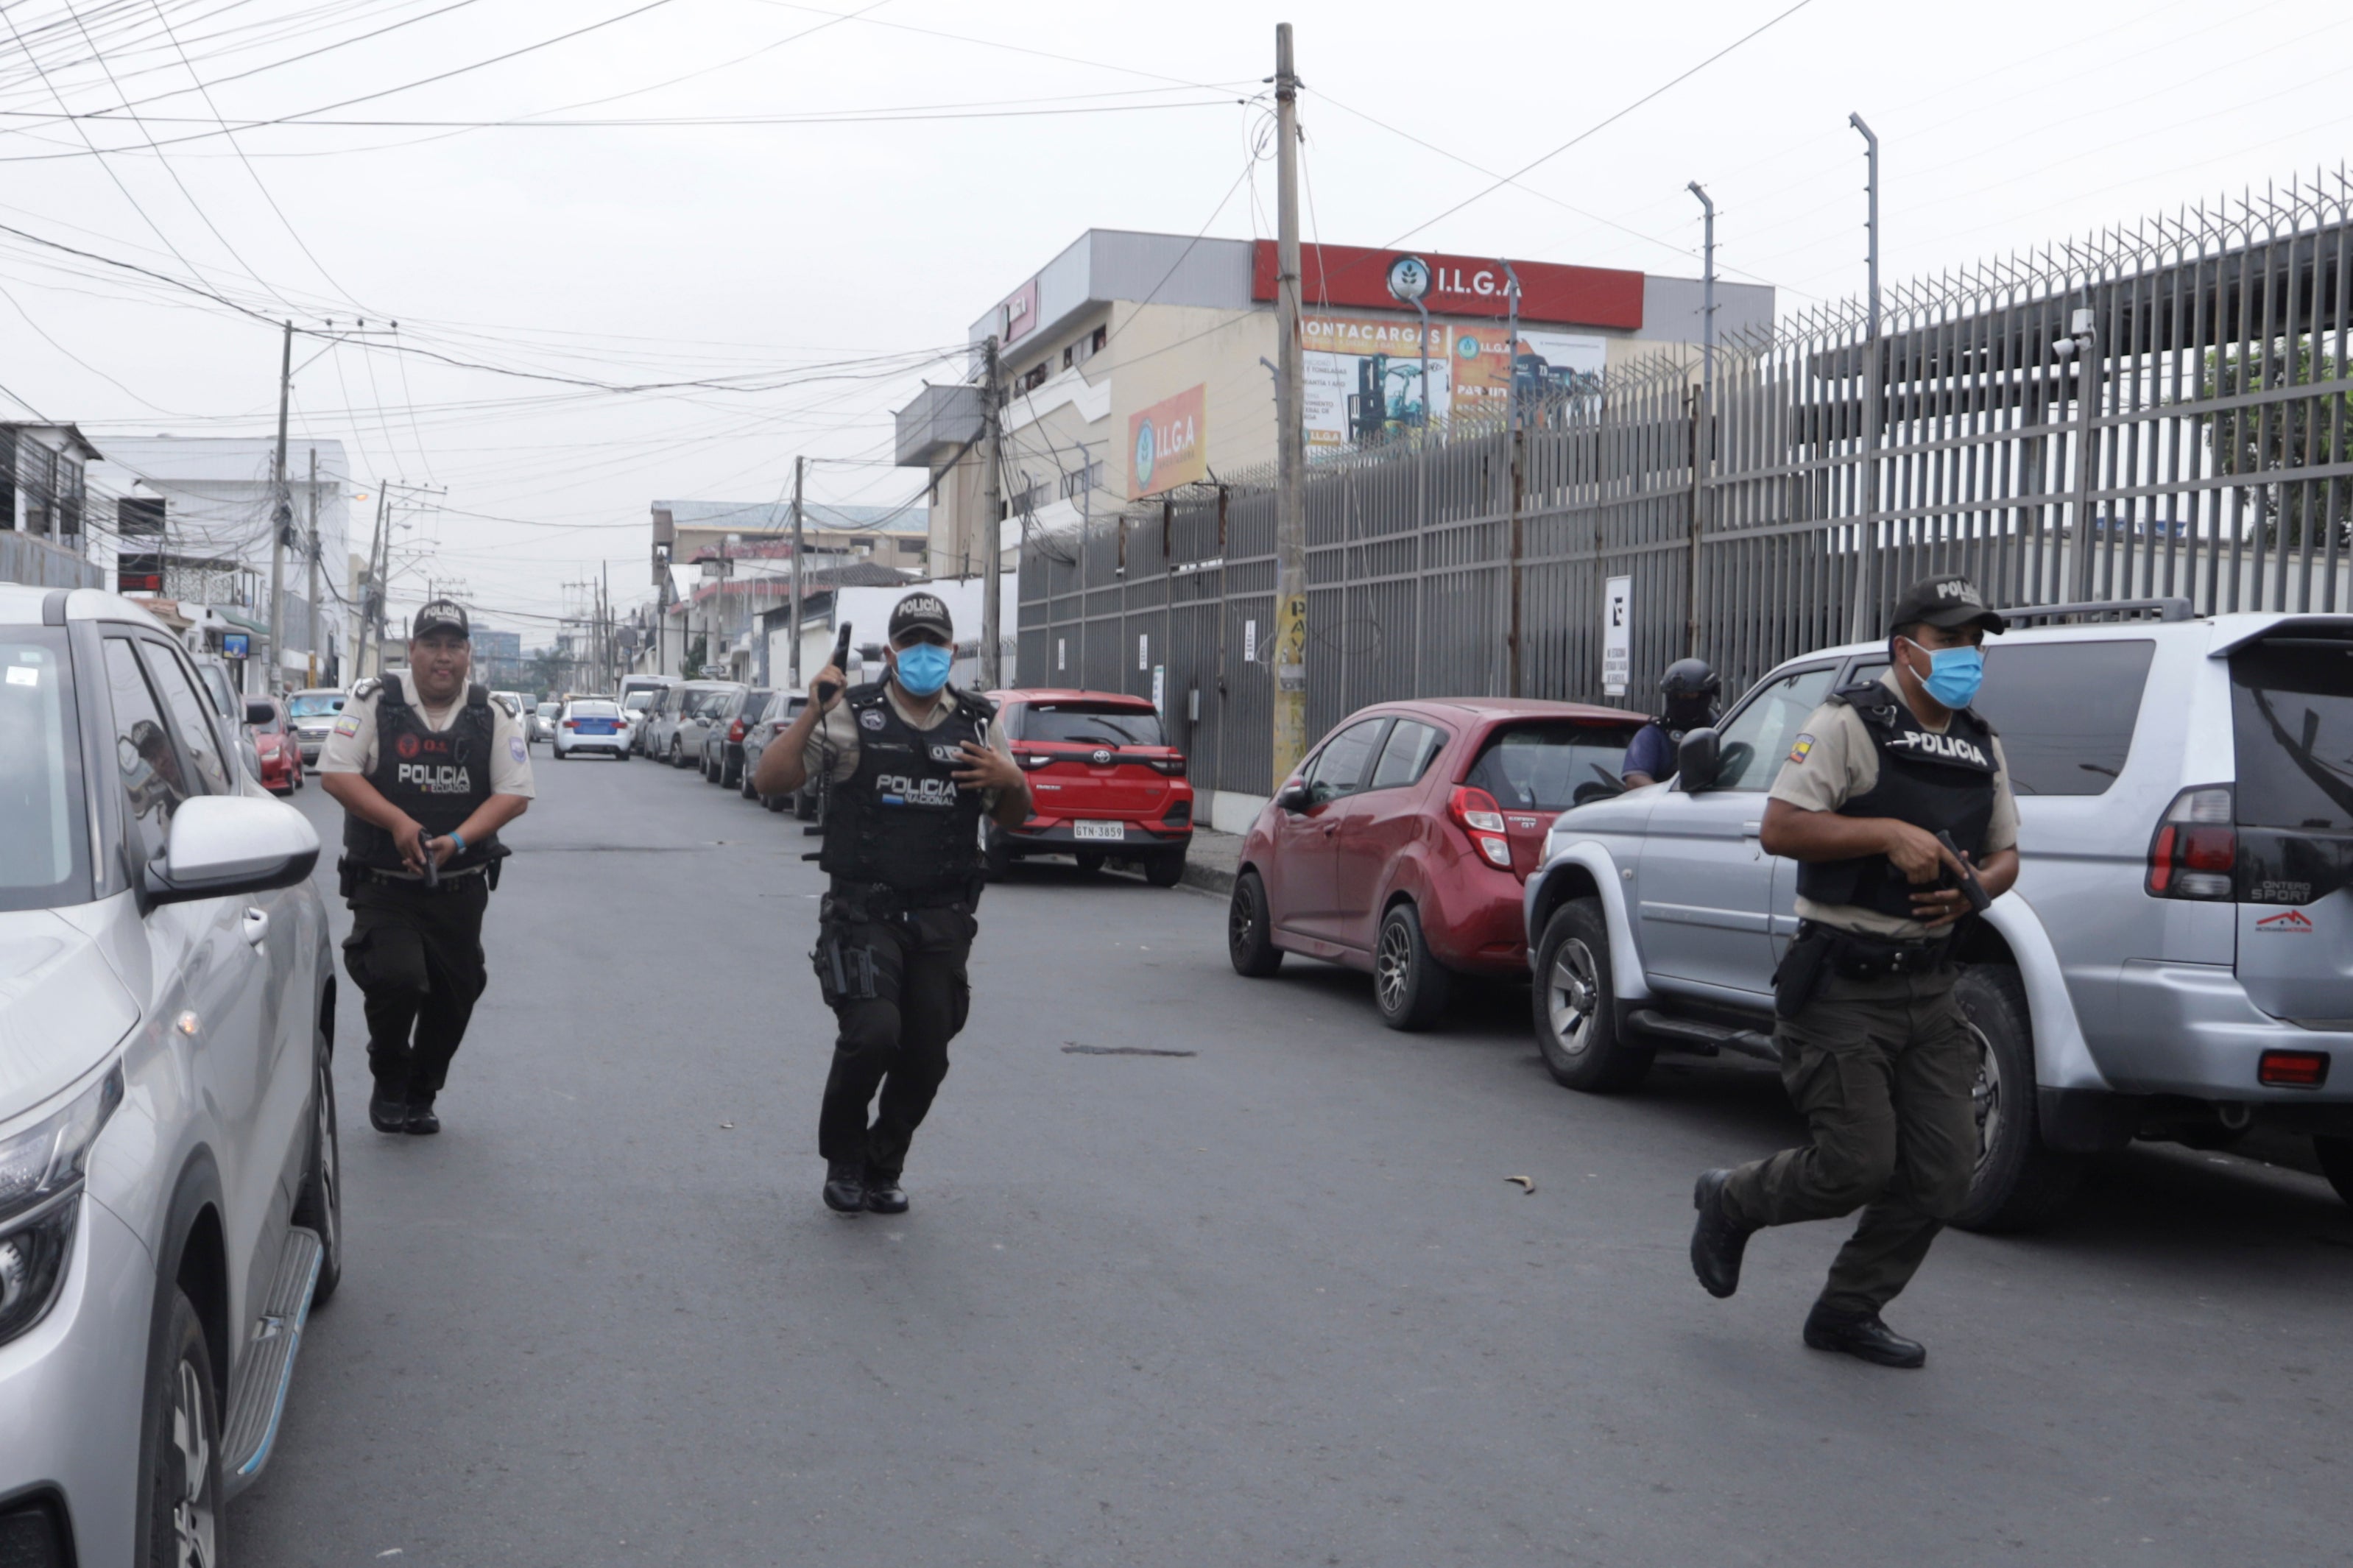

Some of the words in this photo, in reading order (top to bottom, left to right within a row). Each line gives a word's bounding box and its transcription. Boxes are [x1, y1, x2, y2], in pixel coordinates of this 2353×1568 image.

[1301, 320, 1440, 344] ONTACARGS
[1903, 730, 1989, 766] POLICIA
[398, 763, 471, 785] POLICIA
[431, 783, 471, 794] ECUADOR
[875, 774, 958, 797] POLICIA
[904, 793, 955, 807] NACIONAL
[2251, 888, 2311, 903] SPORT
